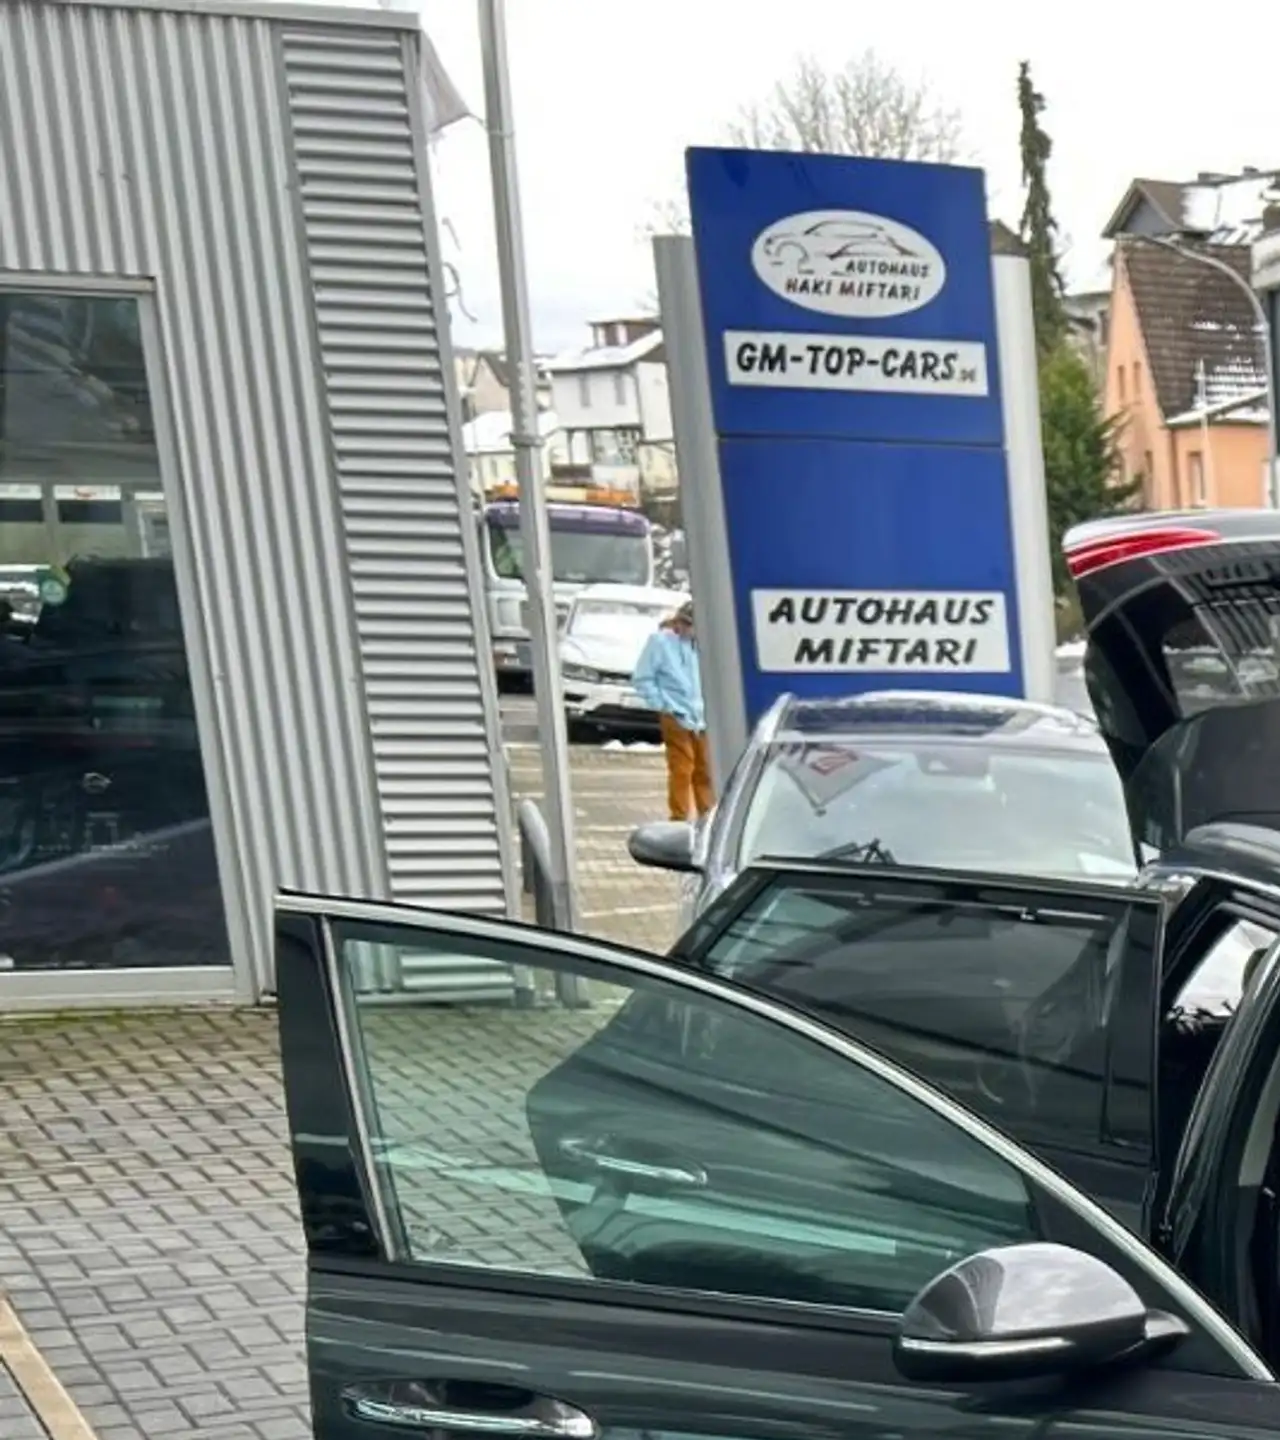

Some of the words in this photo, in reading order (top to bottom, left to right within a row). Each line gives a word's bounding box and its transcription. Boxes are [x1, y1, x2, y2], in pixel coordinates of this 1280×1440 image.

[845, 259, 931, 279] AUTOHAUS
[785, 277, 832, 296] HAKI
[839, 279, 921, 302] MIFTARI
[768, 597, 994, 625] AUTOHAUS
[794, 637, 978, 665] MIFTARI
